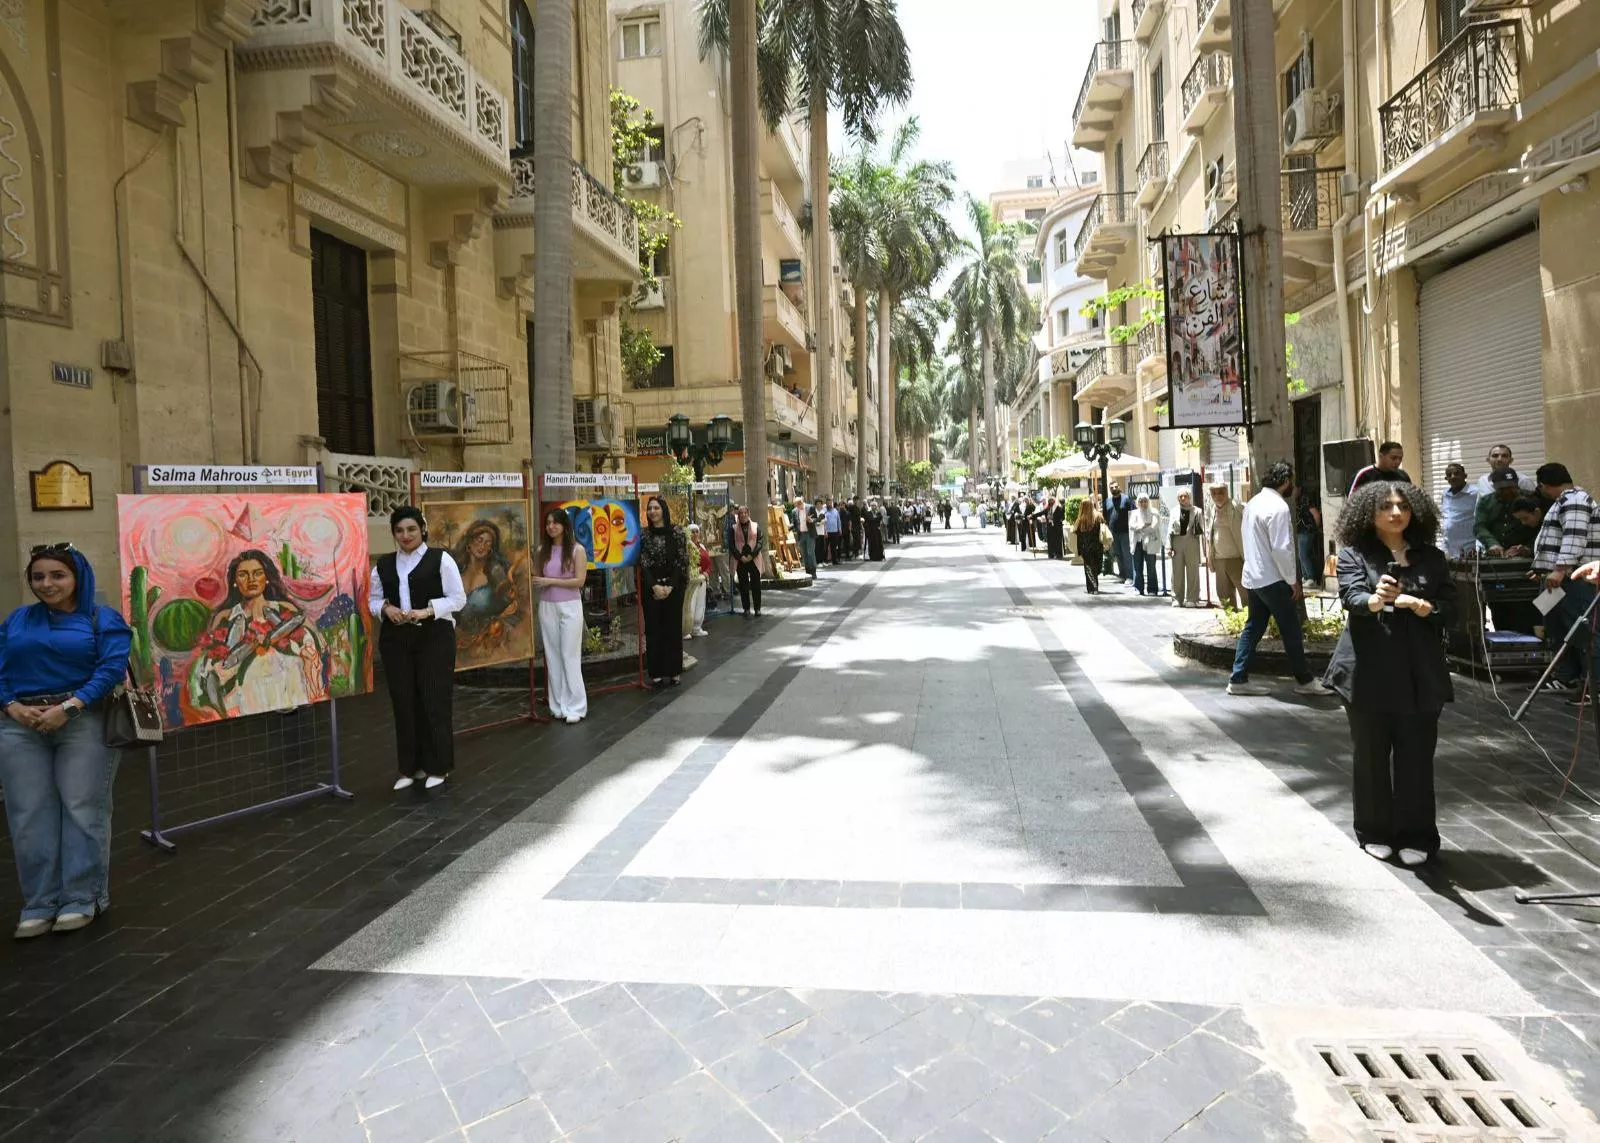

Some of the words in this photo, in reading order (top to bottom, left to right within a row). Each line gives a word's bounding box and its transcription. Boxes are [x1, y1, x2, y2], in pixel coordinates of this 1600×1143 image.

[1189, 278, 1227, 315] شارع
[1185, 302, 1224, 338] الفن
[151, 467, 196, 482] Salma
[200, 468, 258, 482] Mahrous
[285, 468, 313, 478] Egypt
[422, 473, 463, 484] Nourhan
[464, 473, 485, 484] Latif
[546, 474, 568, 484] Hanen
[569, 474, 597, 484] Hamada
